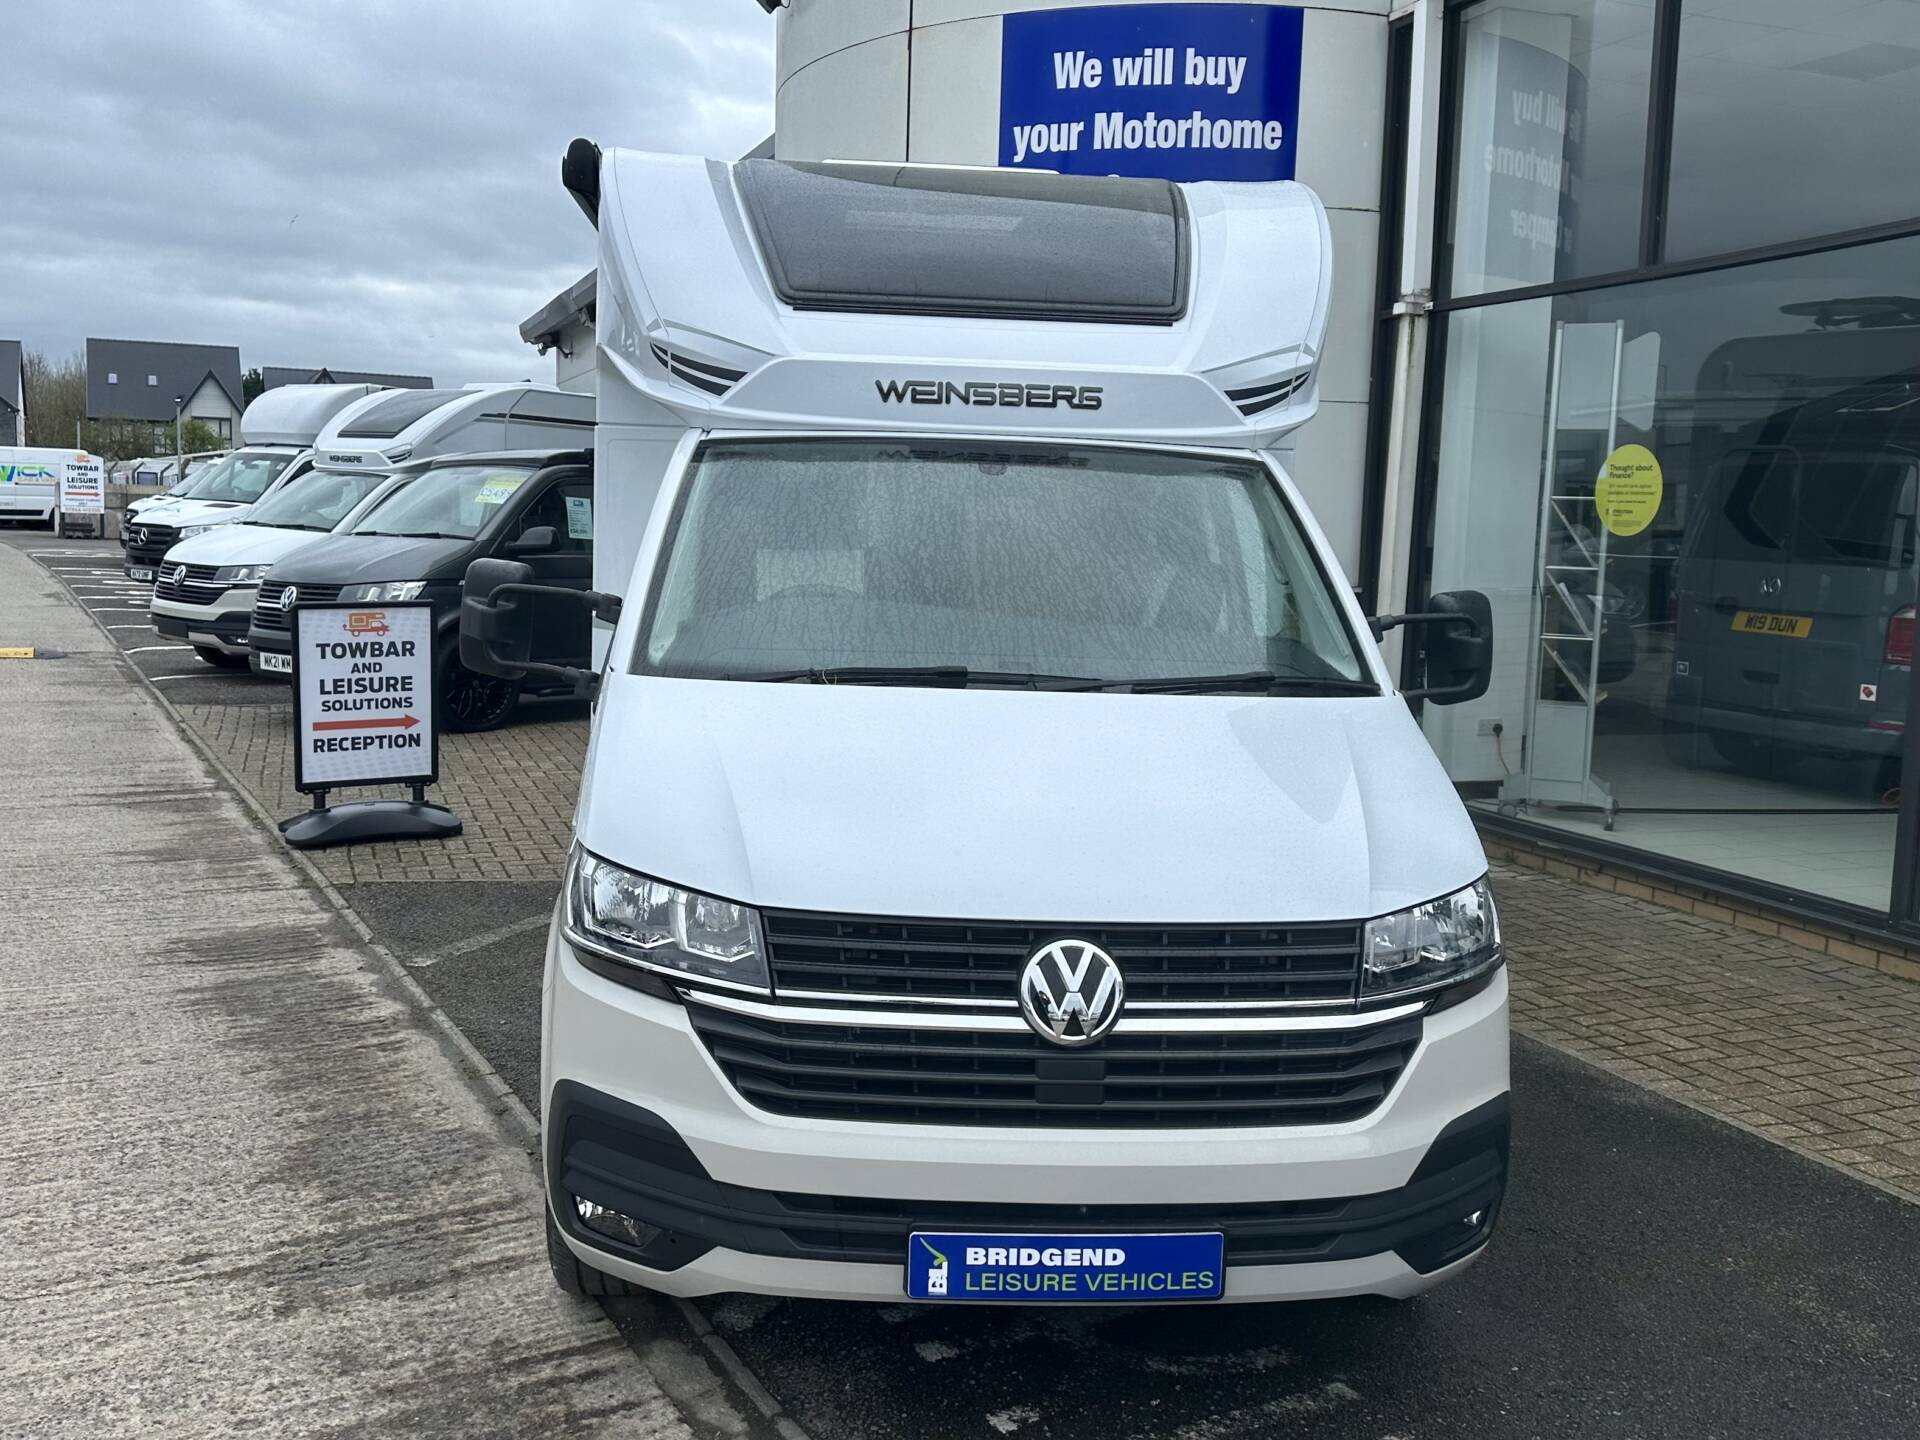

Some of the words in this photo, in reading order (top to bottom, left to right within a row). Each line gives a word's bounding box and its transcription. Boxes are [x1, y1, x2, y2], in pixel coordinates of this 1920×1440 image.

[1053, 51, 1102, 89] We
[1112, 47, 1174, 86] will
[1184, 47, 1247, 94] buy
[1013, 121, 1084, 163] your
[1093, 111, 1283, 151] Motorhome
[875, 379, 1104, 410] WEINSBERG
[66, 464, 99, 472] TOWBAR
[66, 476, 98, 484] LEISURE
[1767, 616, 1799, 633] DUN
[315, 640, 416, 660] TOWBAR
[350, 662, 383, 674] AND
[319, 675, 413, 696] LEISURE
[321, 696, 414, 712] SOLUTIONS
[313, 733, 422, 753] RECEPTION
[965, 1247, 1126, 1267] BRIDGEND
[965, 1272, 1077, 1292] LEISURE
[1084, 1271, 1214, 1292] VEHICLES
